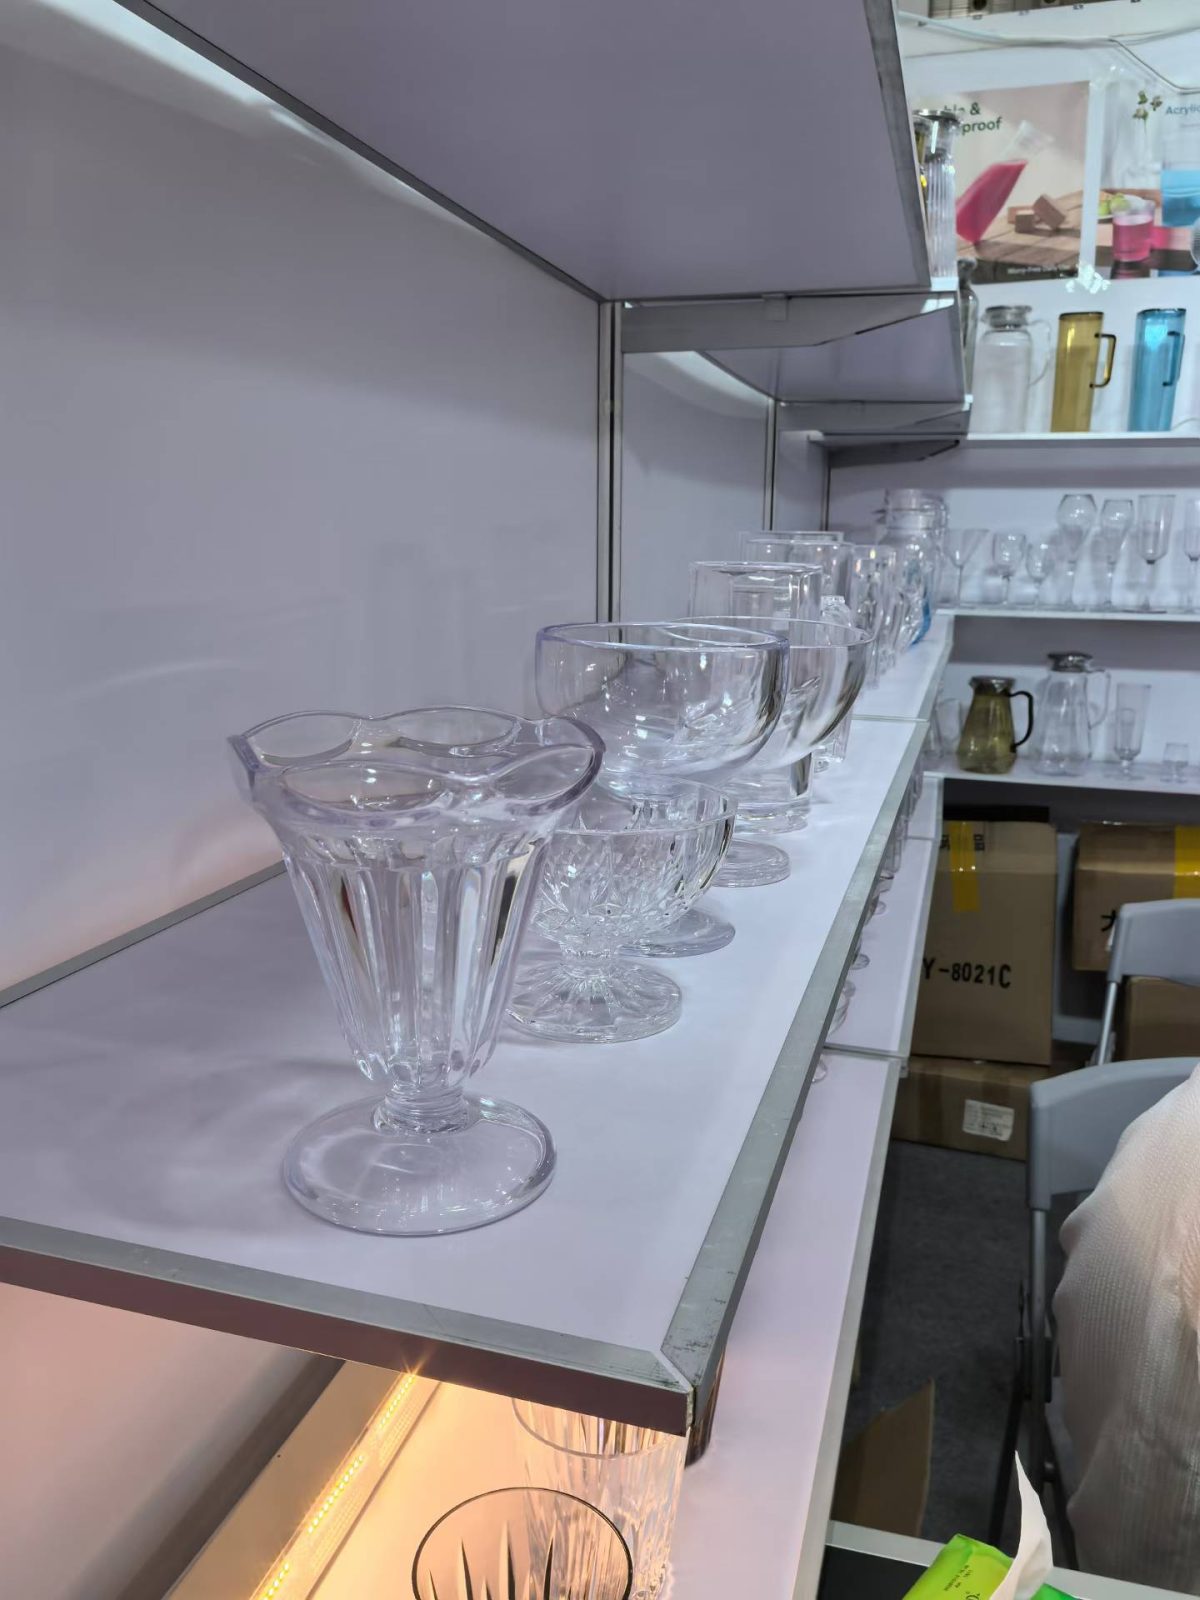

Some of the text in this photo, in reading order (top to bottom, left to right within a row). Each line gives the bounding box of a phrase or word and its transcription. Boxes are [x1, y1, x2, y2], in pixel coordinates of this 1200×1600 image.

[969, 102, 981, 116] &
[962, 116, 1003, 136] proof
[922, 957, 1011, 989] Y-8021C
